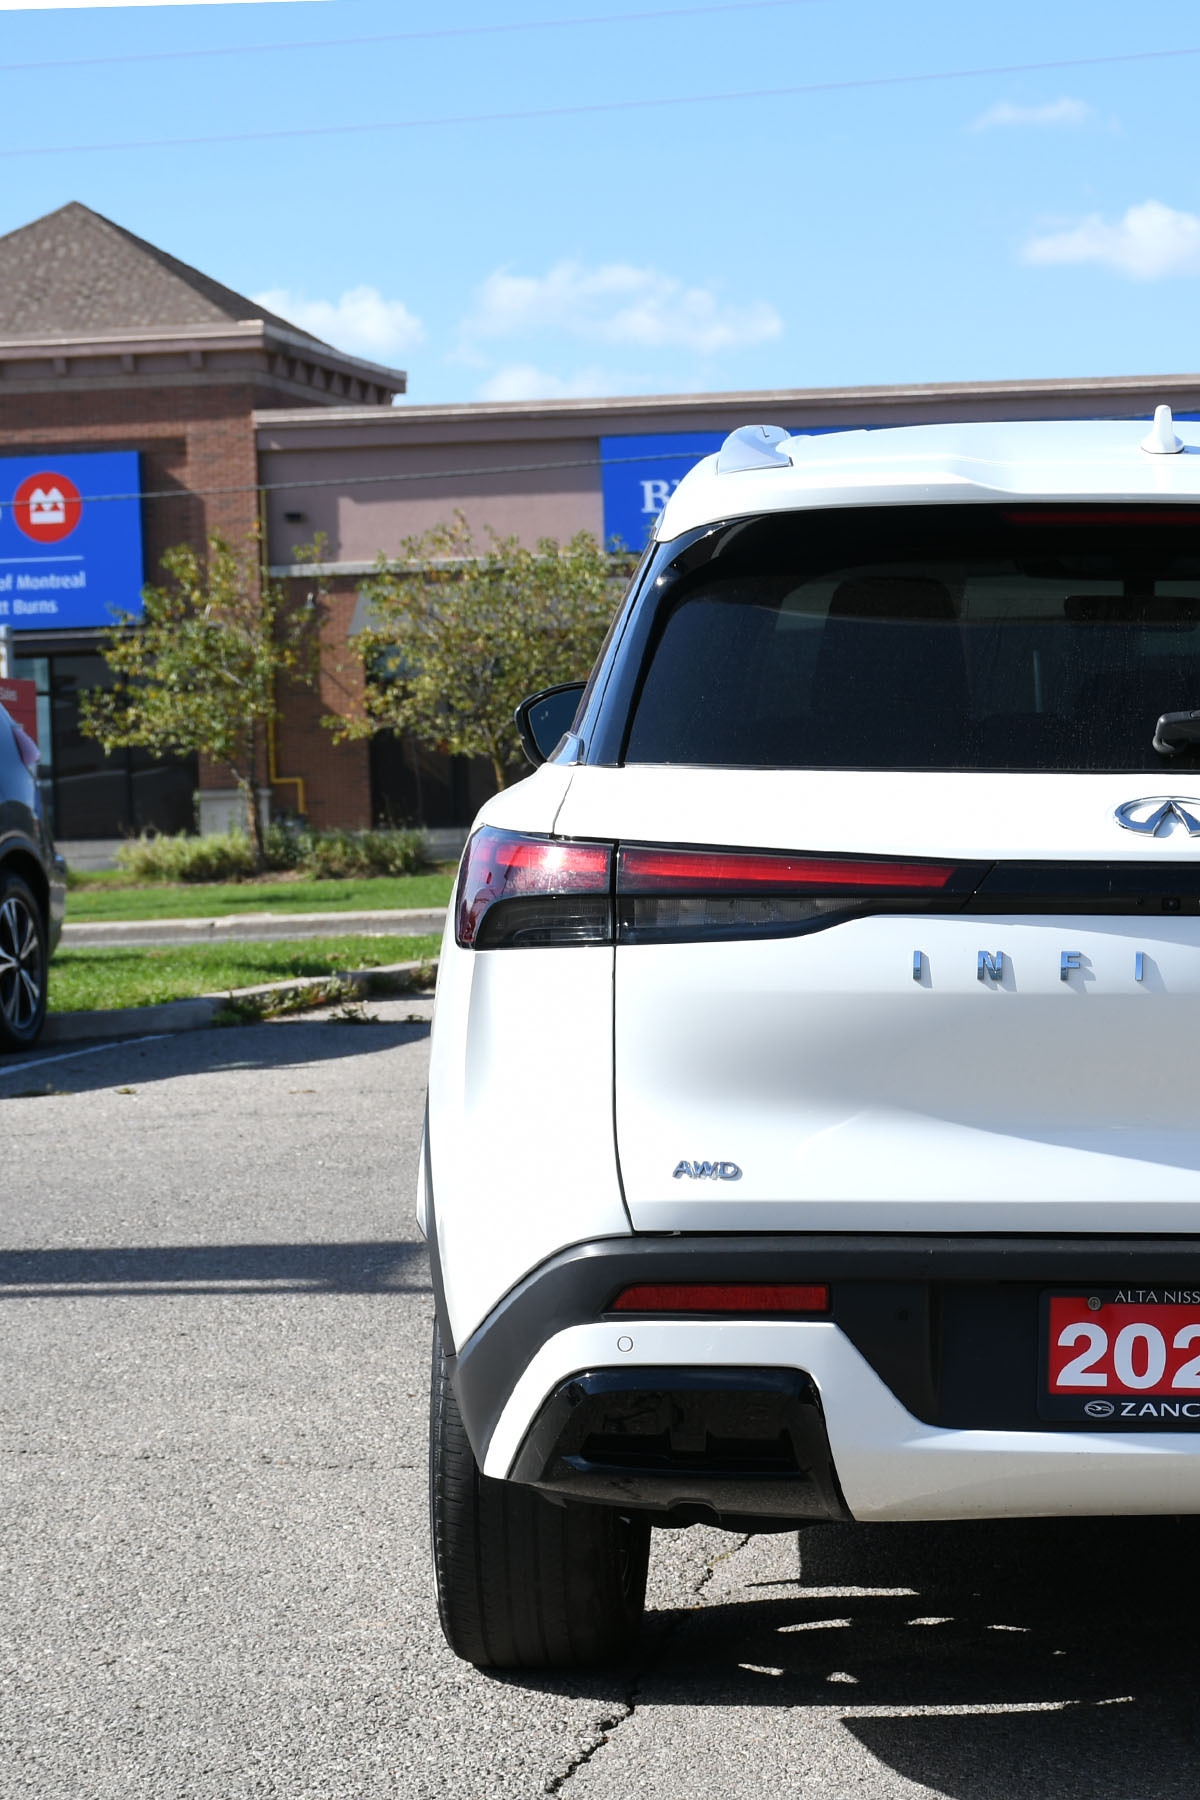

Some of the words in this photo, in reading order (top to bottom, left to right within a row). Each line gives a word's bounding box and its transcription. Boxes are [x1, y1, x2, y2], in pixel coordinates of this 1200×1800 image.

[16, 571, 86, 589] Montreal
[13, 599, 58, 615] Burns
[672, 1159, 743, 1181] AWD
[1114, 1290, 1158, 1303] ALTA
